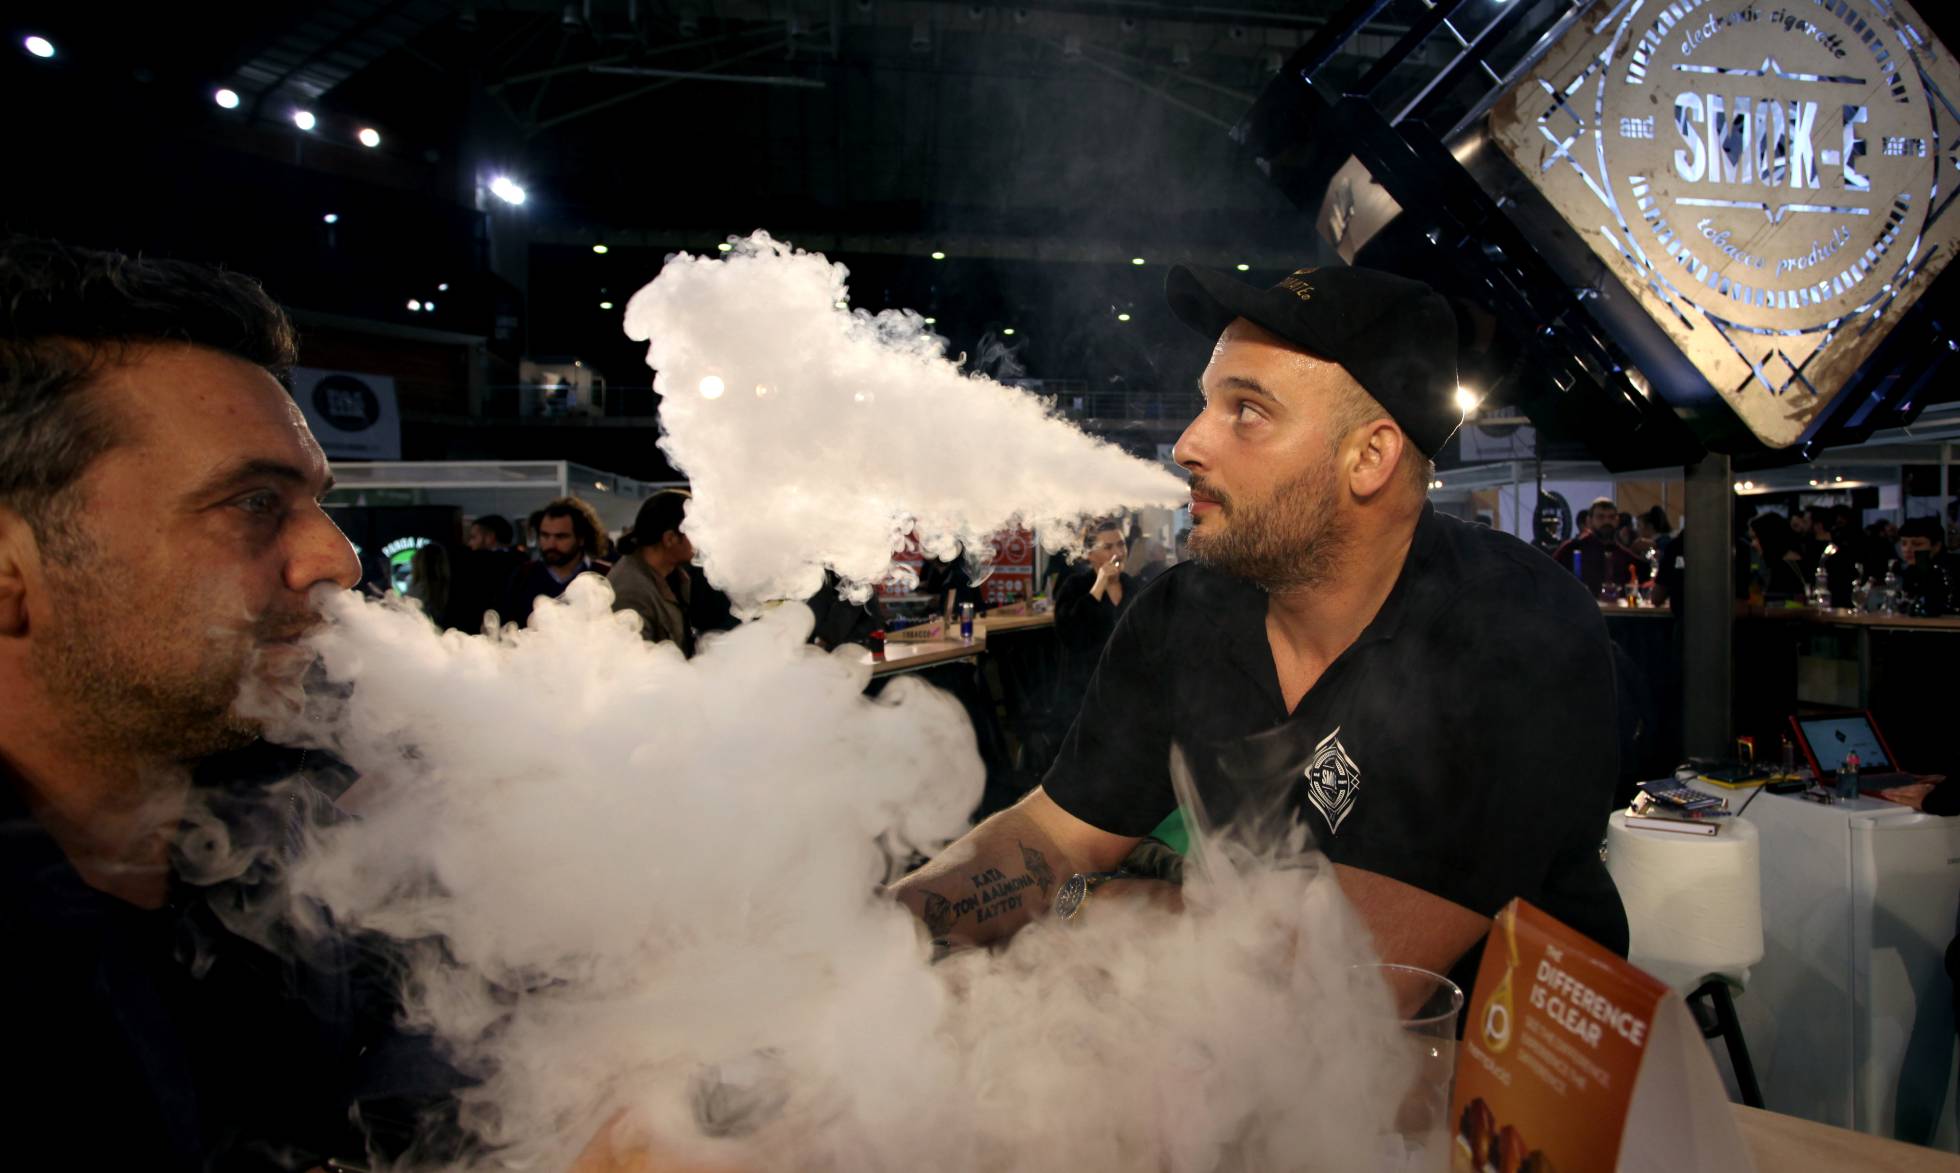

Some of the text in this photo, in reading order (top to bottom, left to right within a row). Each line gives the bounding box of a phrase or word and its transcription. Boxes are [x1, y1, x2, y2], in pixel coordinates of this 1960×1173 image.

[1681, 5, 1846, 59] electronic cigarette
[1619, 115, 1654, 139] and
[1673, 91, 1871, 192] SMOK-E
[1882, 136, 1927, 158] more
[1696, 218, 1851, 279] tobacco products
[1530, 986, 1603, 1049] IS CLEAR
[1536, 961, 1646, 1046] DIFFERENCE
